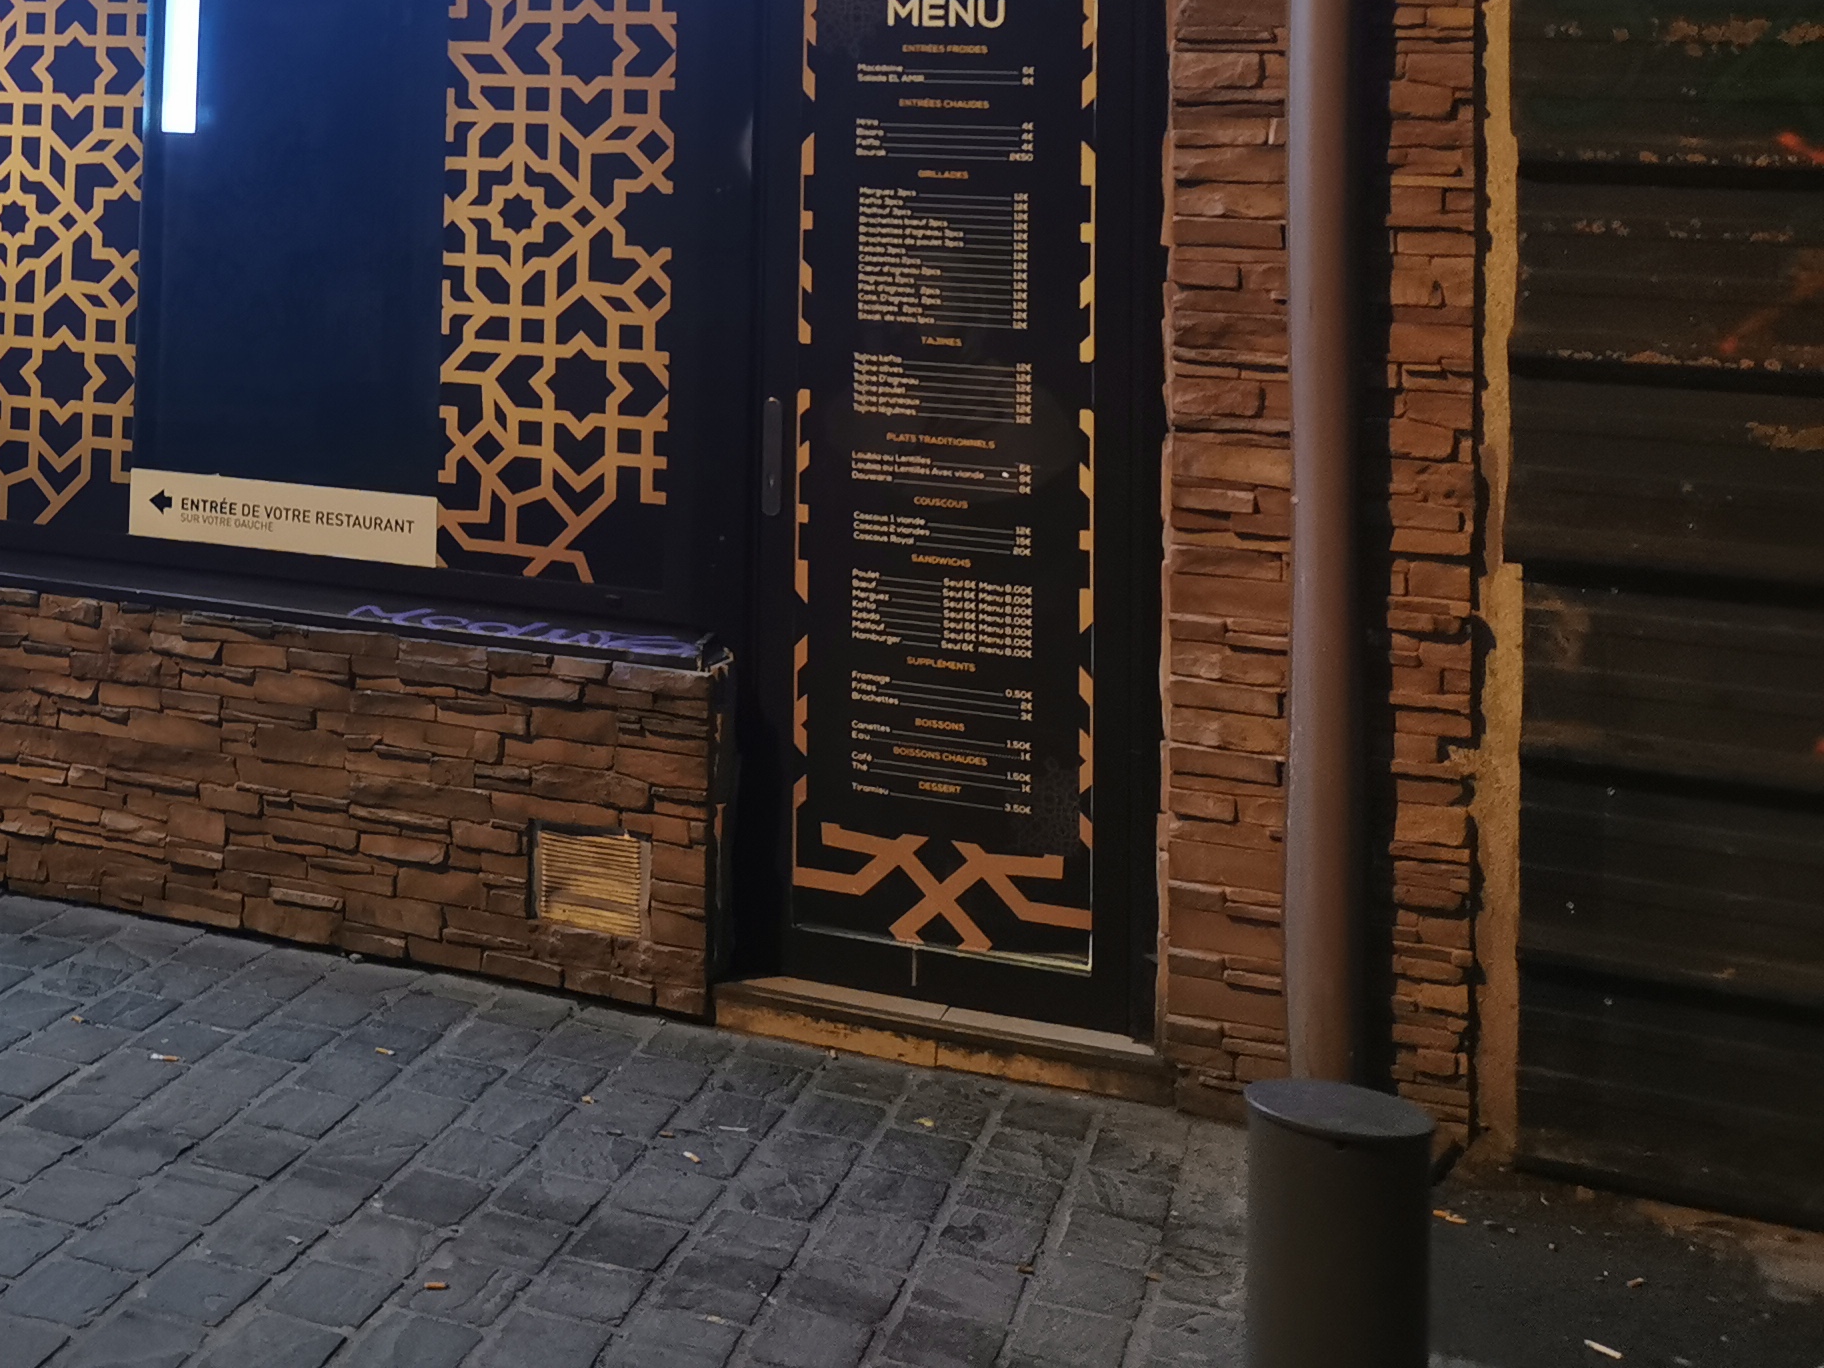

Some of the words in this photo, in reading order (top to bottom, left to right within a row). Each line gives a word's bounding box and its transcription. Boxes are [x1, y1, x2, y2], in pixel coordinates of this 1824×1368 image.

[899, 98, 942, 108] ENTRÉES
[944, 100, 989, 109] CHAUDES
[886, 432, 916, 442] PLATS
[919, 435, 996, 449] TRADITIONNELS
[914, 496, 968, 509] COUSCOUS
[180, 497, 237, 515] ENTRÉE
[241, 504, 260, 518] DE
[264, 505, 311, 523] VOTRE
[315, 512, 415, 534] RESTAURANT
[180, 513, 200, 523] SUR
[201, 515, 231, 527] VOTRE
[912, 553, 971, 567] SANDWICHS
[852, 567, 880, 579] Poulet
[943, 577, 964, 588] Seul
[979, 581, 1004, 592] Menu
[852, 589, 889, 602] Merguez
[943, 598, 963, 609] Seul
[979, 603, 1003, 613] Menu
[943, 588, 963, 599] Seul
[979, 592, 1003, 603] Menu
[943, 609, 963, 620] Seul
[979, 613, 1004, 624] Menu
[943, 619, 963, 630] Seul
[979, 624, 1004, 634] Menu
[852, 630, 902, 645] Hamburger
[941, 640, 961, 651] Seul
[943, 630, 963, 641] Seul
[979, 634, 1003, 645] Menu
[907, 656, 976, 672] SUPPLÉMENTS
[852, 670, 890, 684] Fromage
[852, 681, 877, 692] Frites
[852, 692, 899, 705] Brochettes
[852, 720, 890, 733] Canettes
[915, 718, 965, 732] BOISSONS
[852, 730, 871, 741] Eau
[852, 751, 872, 762] Café
[893, 746, 941, 760] BOISSONS
[942, 752, 988, 766] CHAUDES
[852, 762, 868, 771] Thé
[852, 782, 889, 795] Tiramisu
[918, 781, 962, 793] DESSERT
